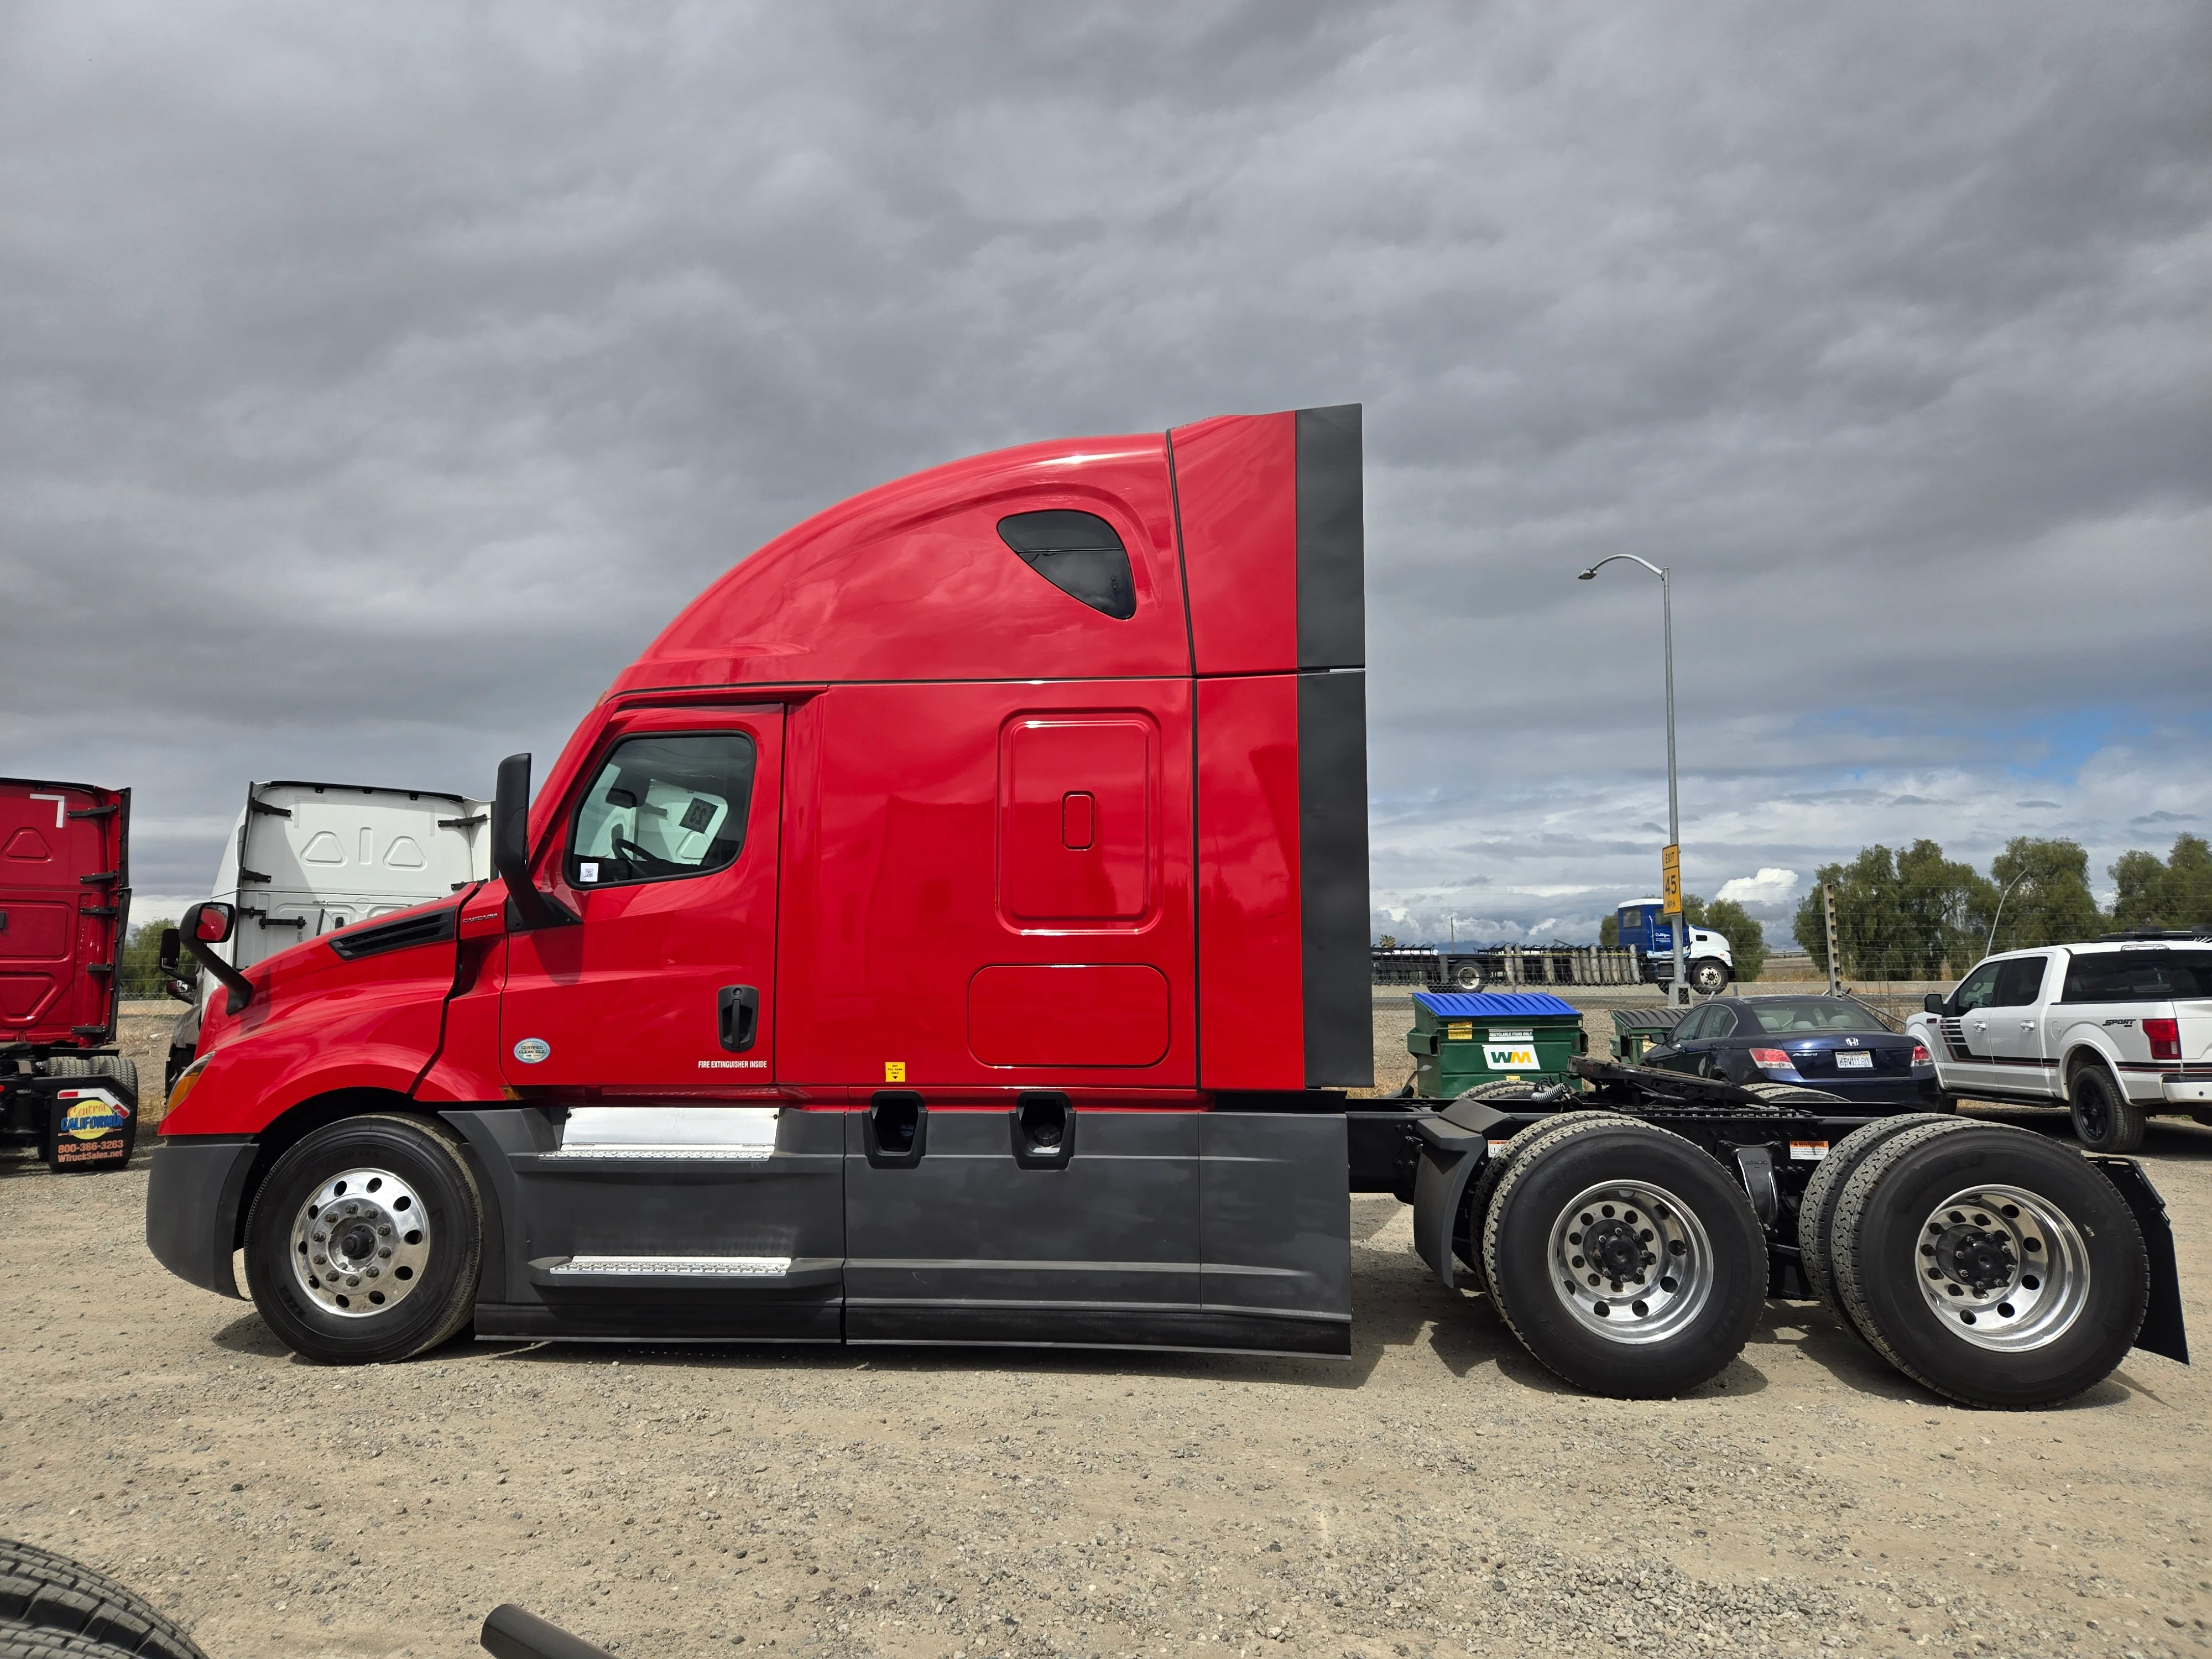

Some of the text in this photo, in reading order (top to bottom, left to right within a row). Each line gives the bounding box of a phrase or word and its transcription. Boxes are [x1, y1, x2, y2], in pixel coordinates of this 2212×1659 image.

[1665, 852, 1675, 864] EXIT
[1665, 874, 1677, 895] 45
[1490, 1051, 1532, 1063] WM
[67, 1103, 108, 1118] Central
[61, 1113, 124, 1131] CALIFORNIA
[58, 1140, 123, 1154] 800-366-3263
[58, 1150, 123, 1162] WTruckSales.net
